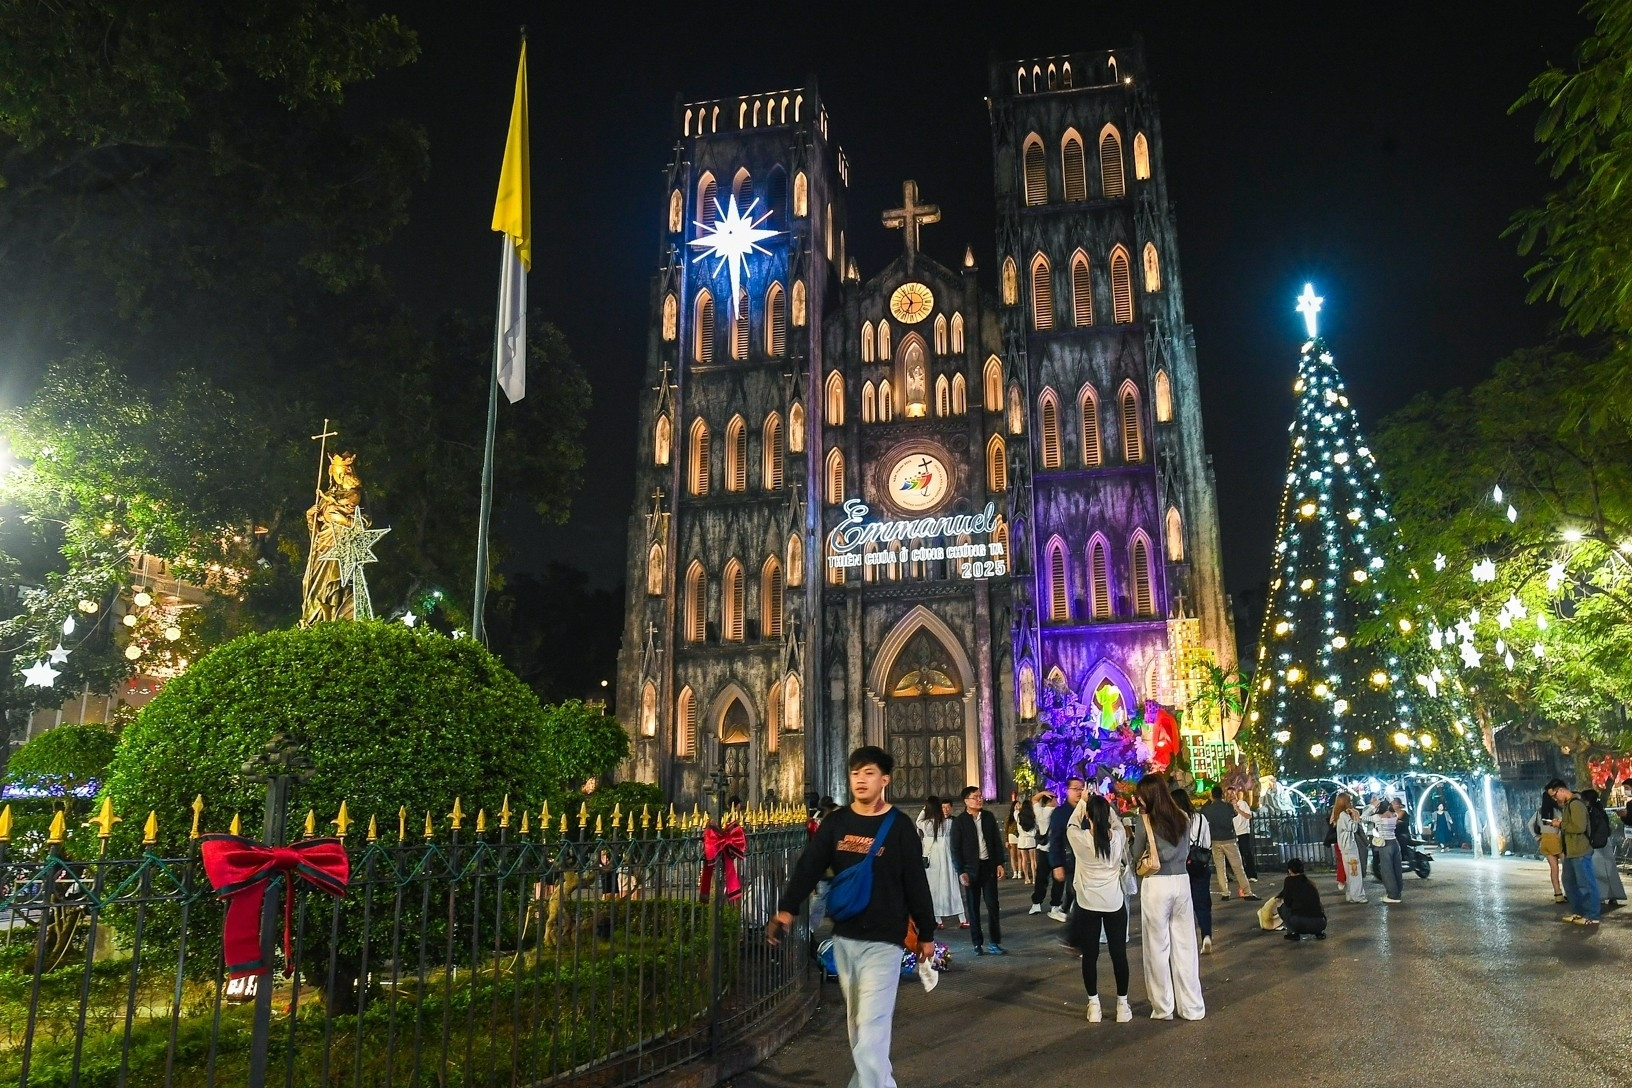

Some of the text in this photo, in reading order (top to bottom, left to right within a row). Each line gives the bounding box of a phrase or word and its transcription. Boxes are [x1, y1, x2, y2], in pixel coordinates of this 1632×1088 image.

[831, 498, 997, 552] Emmanuel
[828, 553, 862, 567] THIÊN
[865, 550, 897, 564] CHÚA
[946, 543, 986, 558] CHÚNG
[988, 542, 1003, 555] TA
[961, 560, 1006, 578] 2025
